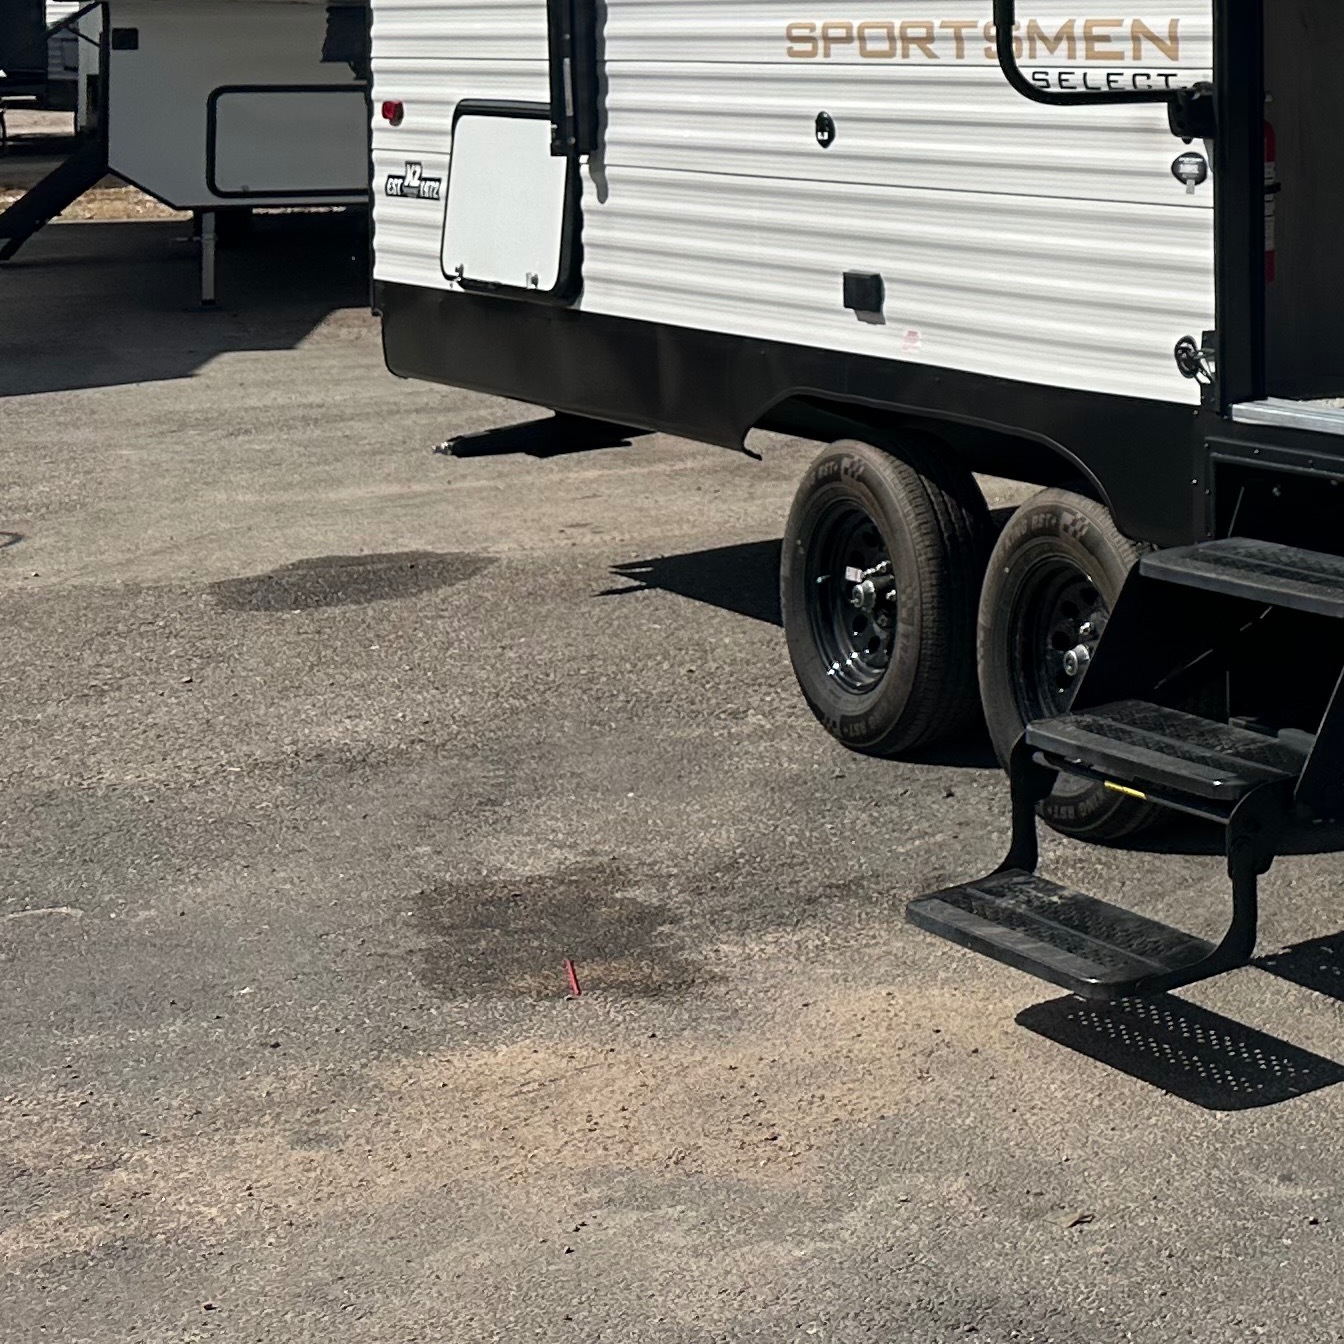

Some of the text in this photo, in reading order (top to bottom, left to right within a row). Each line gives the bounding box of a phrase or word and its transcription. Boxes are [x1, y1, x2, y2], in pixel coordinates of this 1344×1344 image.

[785, 18, 1180, 61] SPORTSMEN
[1032, 71, 1178, 90] SELECT
[387, 178, 403, 196] EST
